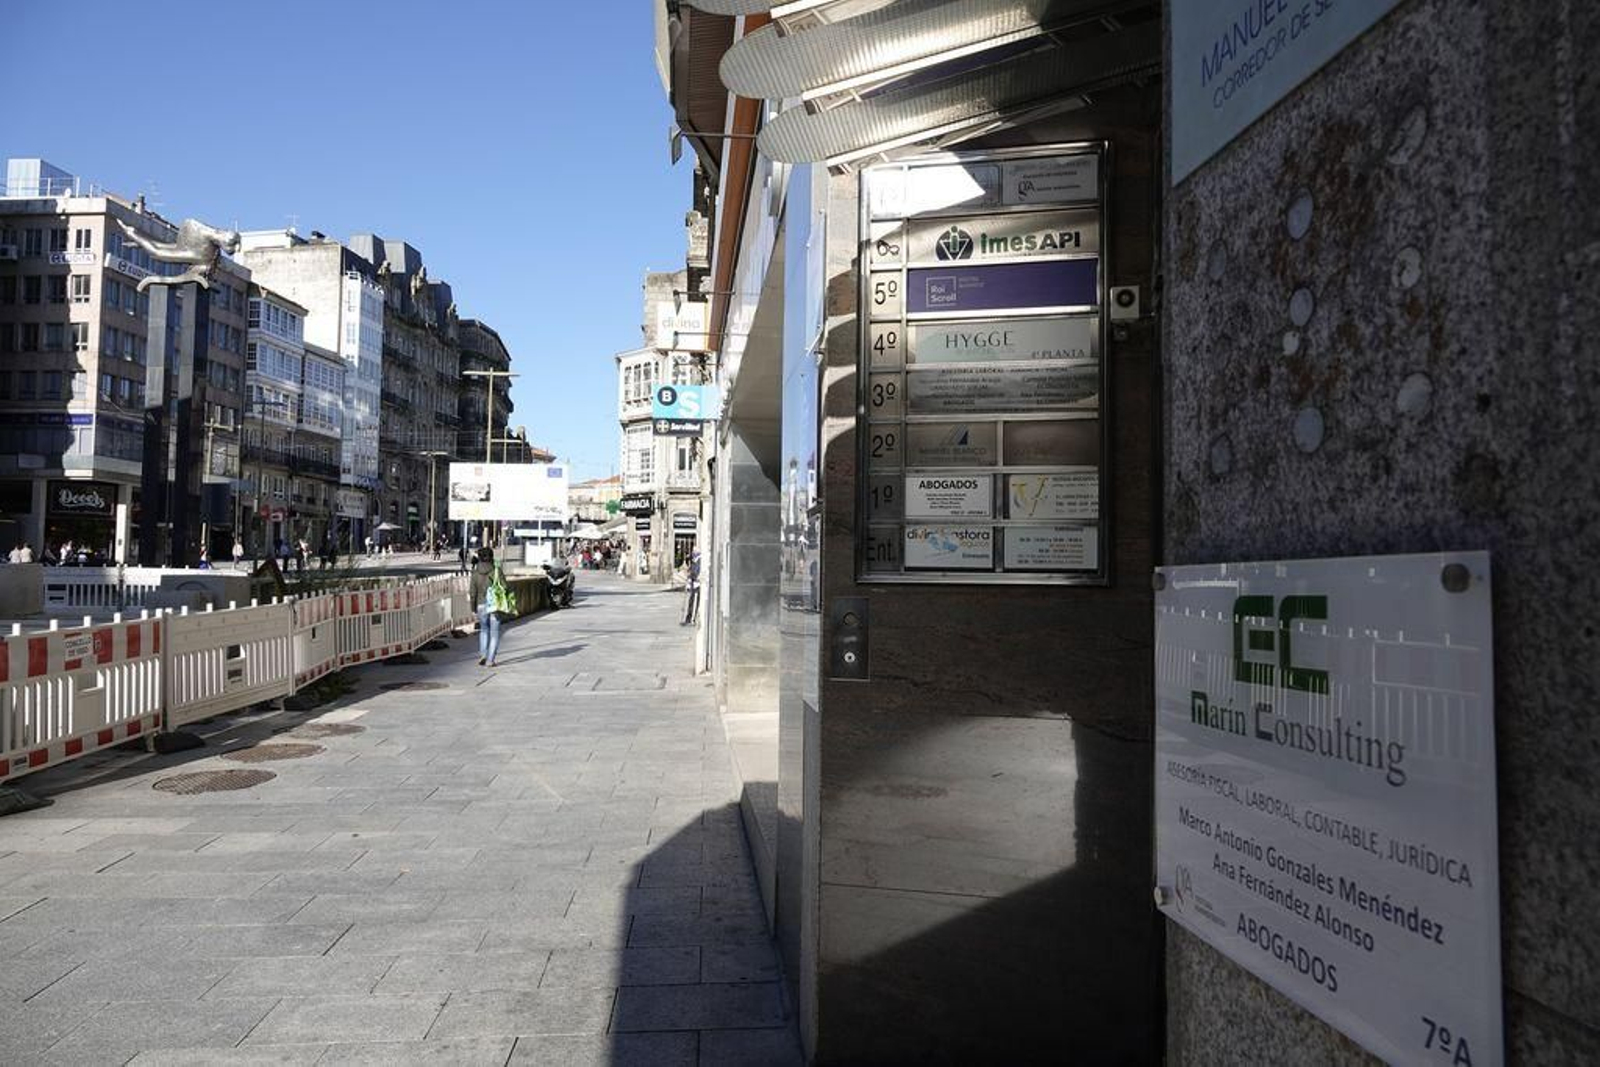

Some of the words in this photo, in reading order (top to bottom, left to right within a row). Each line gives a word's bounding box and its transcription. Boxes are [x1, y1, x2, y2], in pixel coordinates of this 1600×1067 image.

[1212, 27, 1286, 109] CORREDOR
[1291, 3, 1310, 40] DE
[874, 280, 898, 305] 5º
[873, 331, 897, 356] 4º
[946, 330, 1014, 348] HYGGE
[872, 382, 896, 407] 3º
[872, 433, 895, 458] 2º
[871, 485, 893, 510] 1º
[918, 480, 979, 490] ABOGADOS
[1255, 701, 1407, 787] Consulting
[1304, 809, 1384, 860] CONTABLE,
[1387, 843, 1473, 888] JURÍDICA
[1178, 806, 1212, 837] Marco
[1214, 823, 1263, 862] Antonio
[1265, 846, 1334, 896] Gonzales
[1338, 875, 1445, 945] Menéndez
[1212, 852, 1236, 880] Ana
[1238, 865, 1311, 921] Fernández
[1314, 903, 1375, 953] Alonso
[1237, 911, 1339, 993] ABOGADOS
